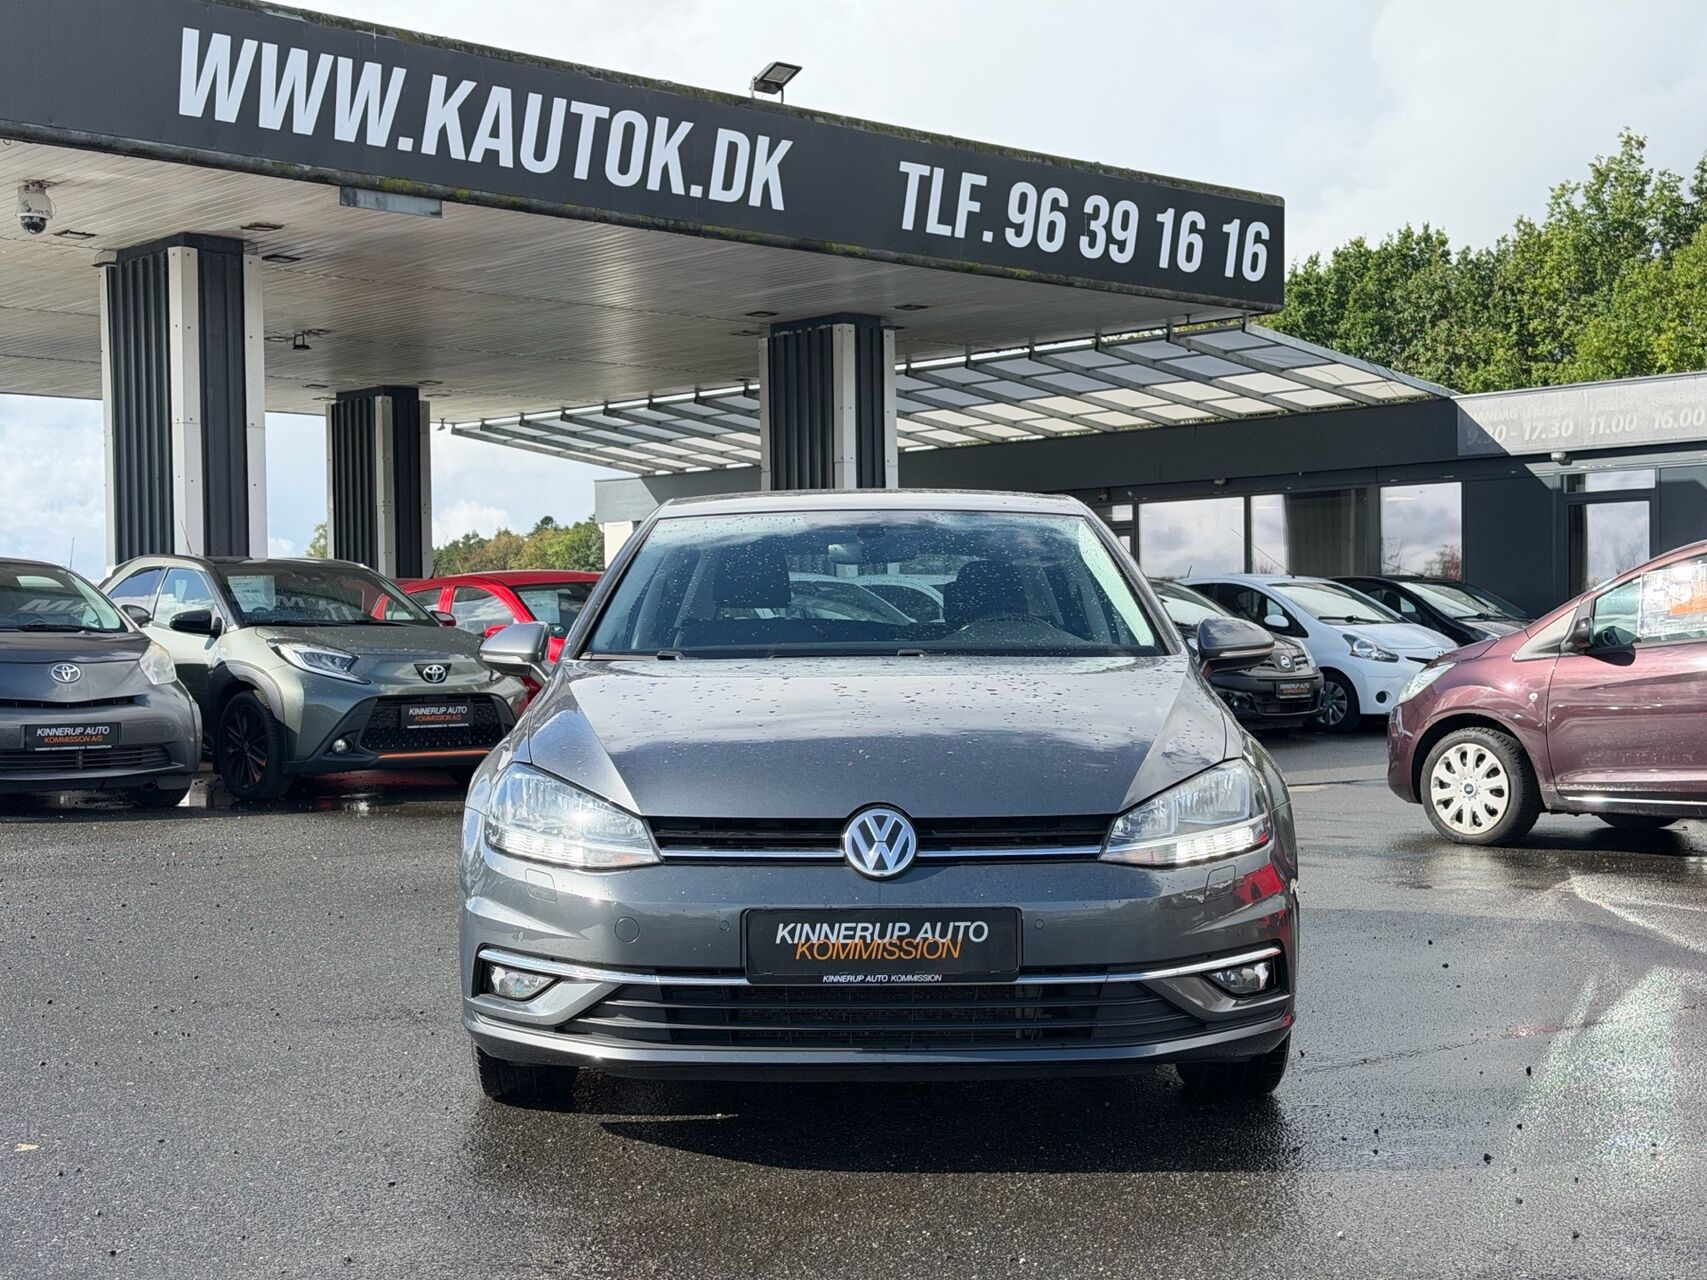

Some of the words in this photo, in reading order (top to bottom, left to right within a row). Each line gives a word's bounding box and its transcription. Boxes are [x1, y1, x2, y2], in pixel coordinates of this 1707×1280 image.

[179, 28, 793, 211] WWW.KAUTOK.DK
[899, 161, 993, 243] TLF.
[1005, 182, 1069, 253] 96
[1079, 195, 1139, 264] 39
[1156, 208, 1206, 273] 16
[1222, 219, 1270, 282] 16
[1523, 419, 1574, 440] 17.30
[1588, 413, 1638, 435] 11.00
[1653, 406, 1706, 430] 16.00
[409, 706, 447, 716] KINNERUP
[447, 705, 468, 715] AUTO
[36, 727, 84, 737] KINNERUP
[84, 725, 110, 735] AUTO
[775, 922, 911, 944] KINNERUP
[915, 921, 989, 943] AUTO
[795, 938, 963, 961] KOMMISSION
[822, 974, 865, 983] KINNERUP
[865, 974, 889, 983] AUTO
[890, 974, 942, 983] KOMMISSION
